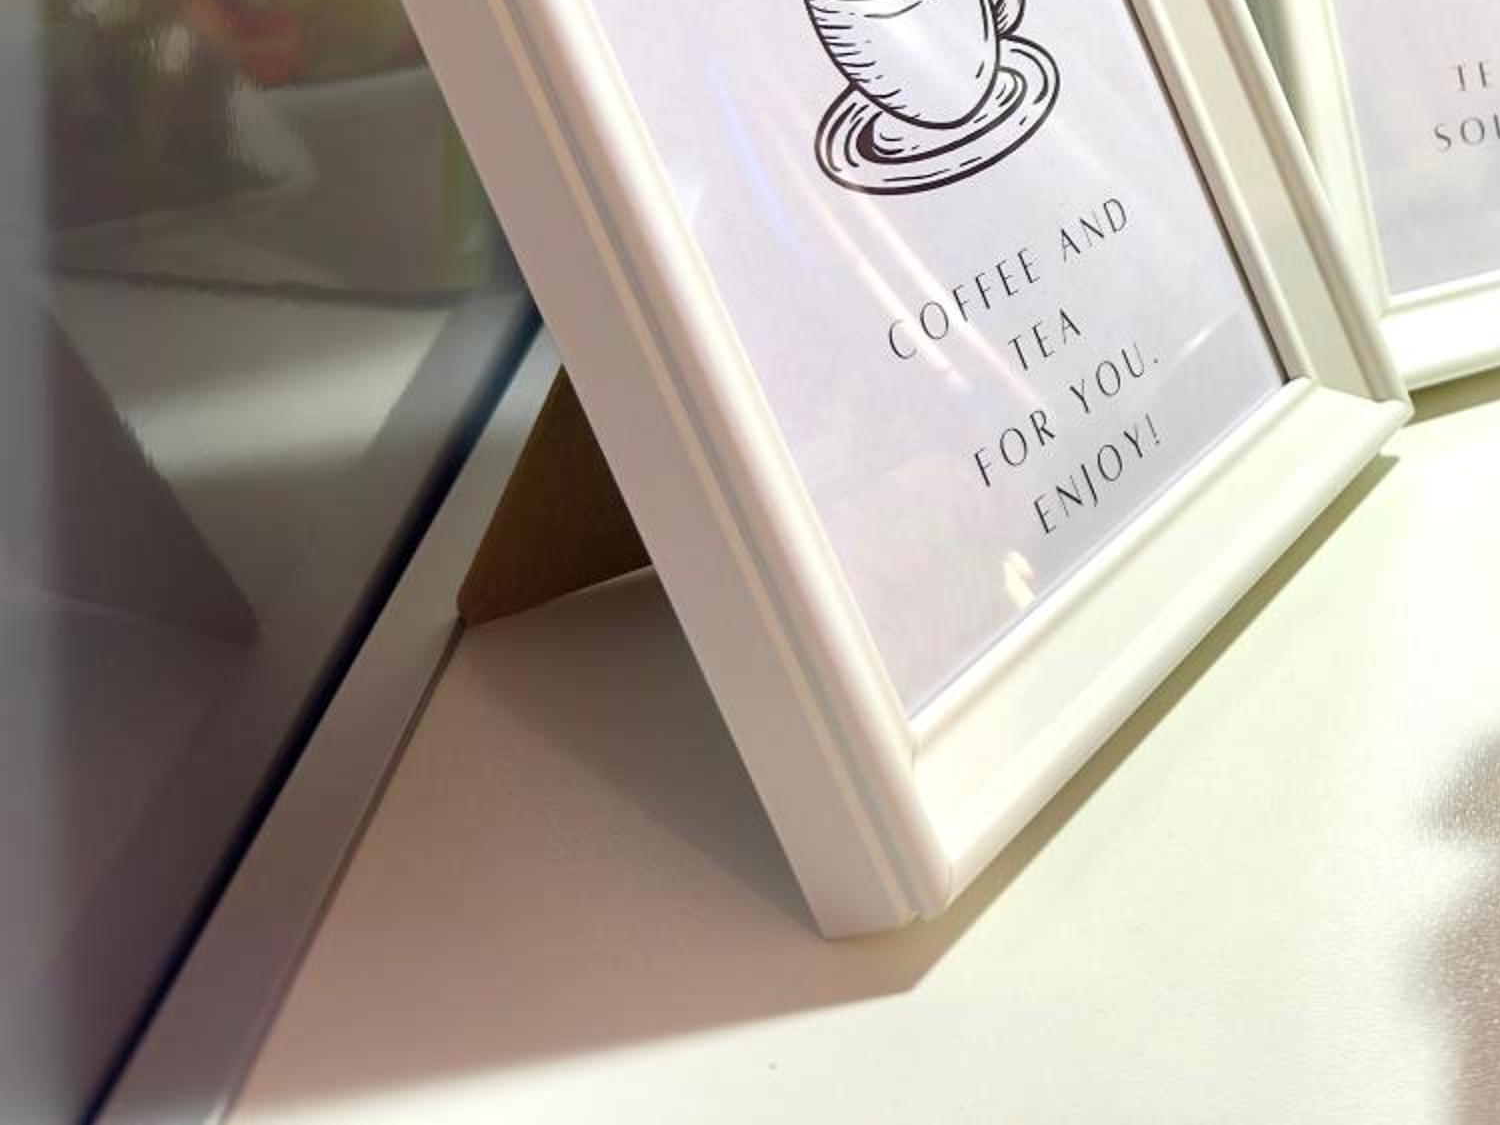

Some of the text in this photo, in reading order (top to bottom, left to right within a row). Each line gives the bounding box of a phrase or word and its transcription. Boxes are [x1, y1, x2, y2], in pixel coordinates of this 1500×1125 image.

[889, 198, 1128, 360] COFFEE AND
[1008, 307, 1082, 372] TEA
[973, 343, 1160, 488] FOR YOU.
[1033, 413, 1161, 534] ENJOY!
